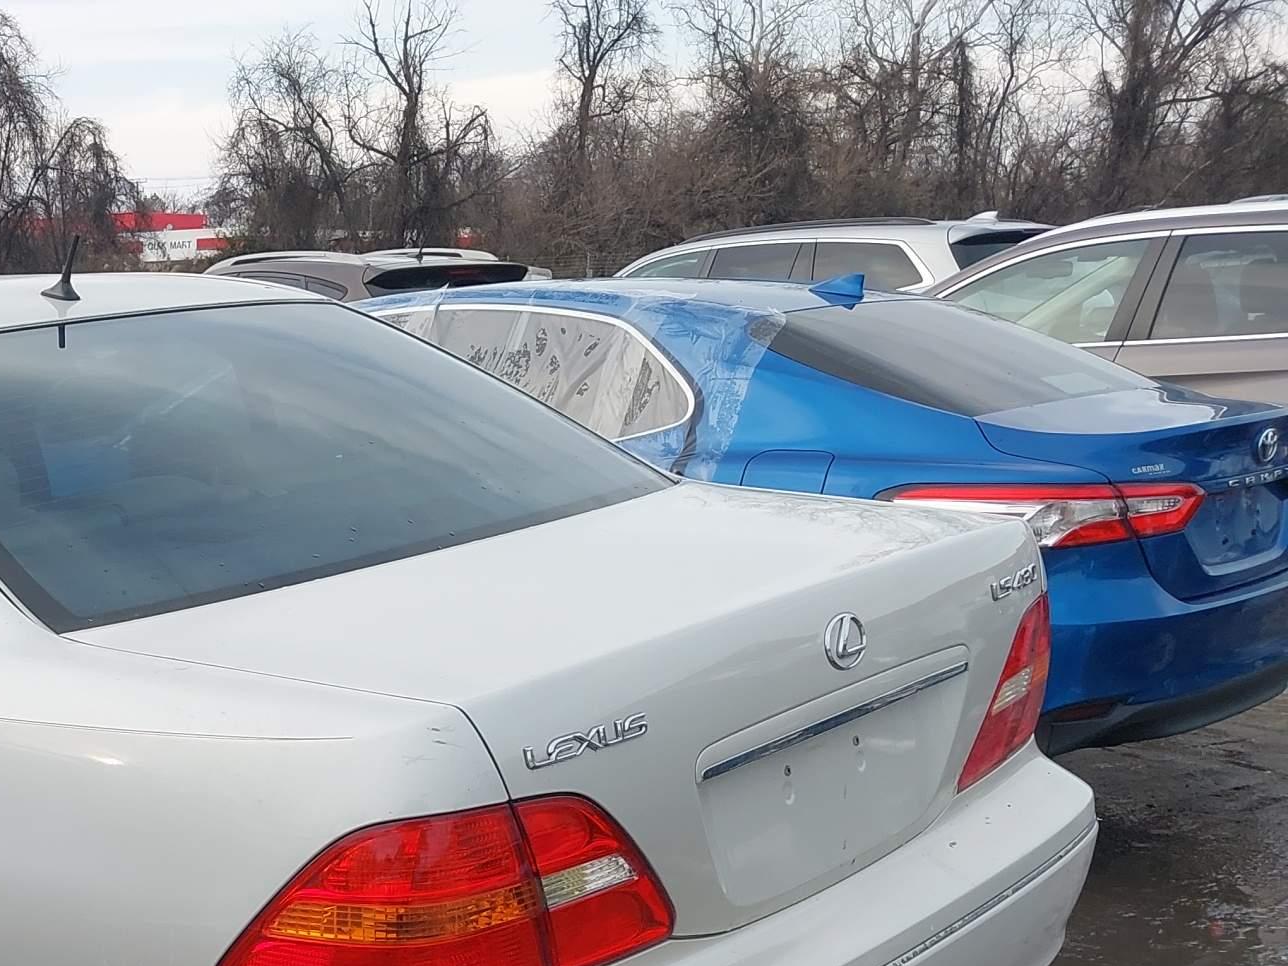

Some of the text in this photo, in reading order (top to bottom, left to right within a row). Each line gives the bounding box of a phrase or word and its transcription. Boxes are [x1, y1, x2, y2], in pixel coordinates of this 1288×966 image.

[169, 240, 193, 249] MART
[1228, 467, 1288, 487] CAMR
[522, 712, 648, 770] LEXUS
